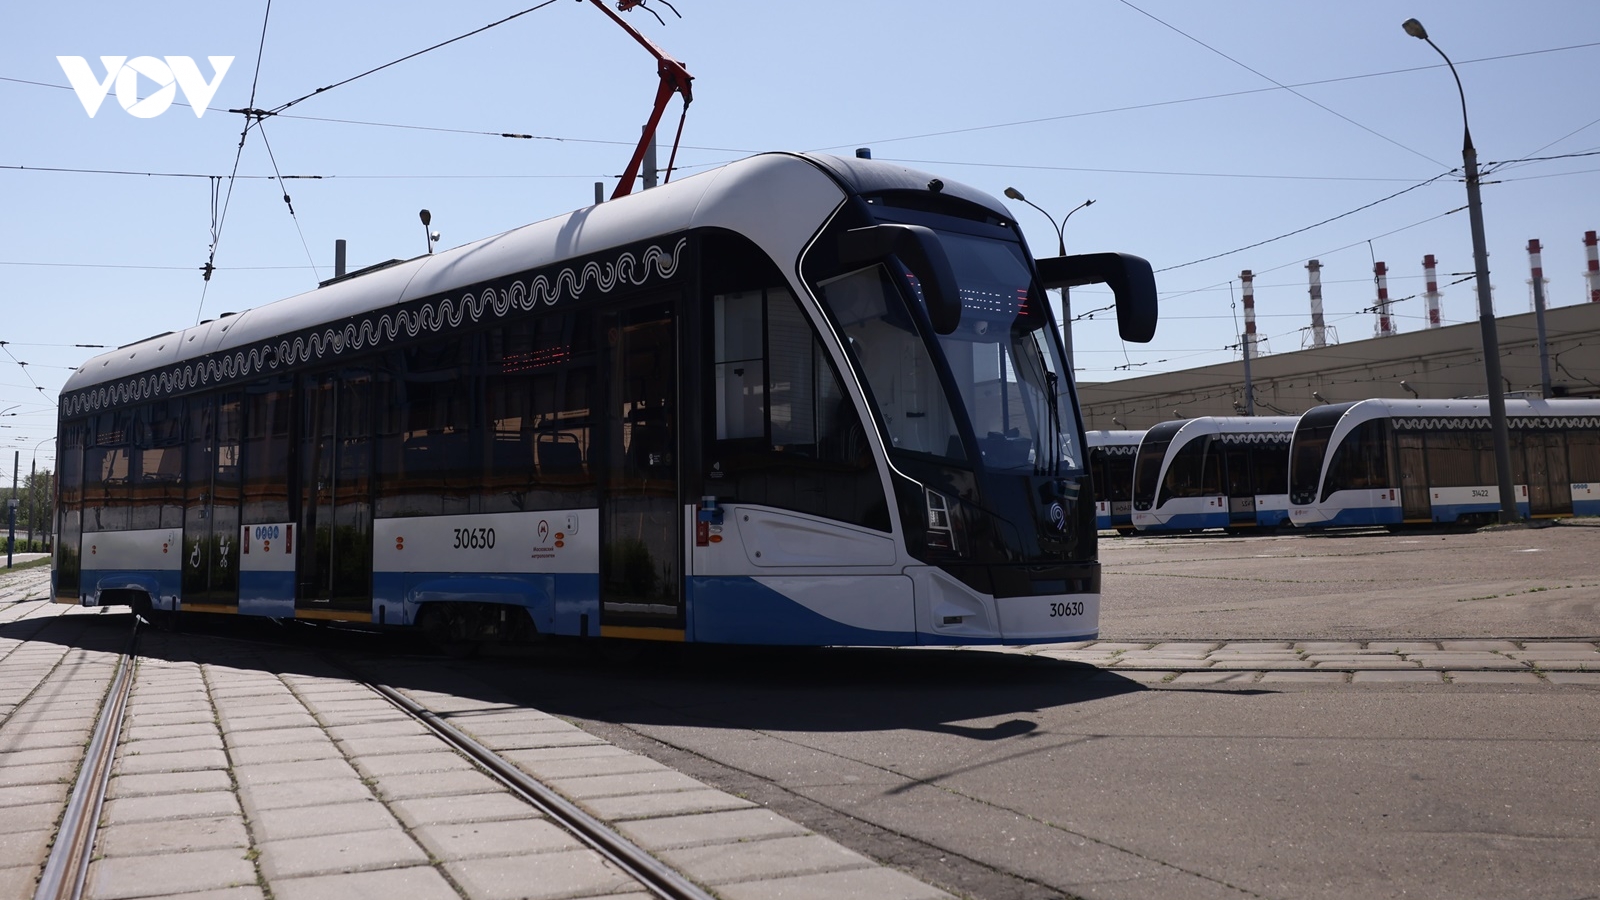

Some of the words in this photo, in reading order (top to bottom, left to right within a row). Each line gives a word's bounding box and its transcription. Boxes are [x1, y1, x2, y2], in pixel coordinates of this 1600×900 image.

[1472, 489, 1488, 498] 31422
[453, 528, 495, 549] 30630
[1049, 601, 1084, 617] 30630
